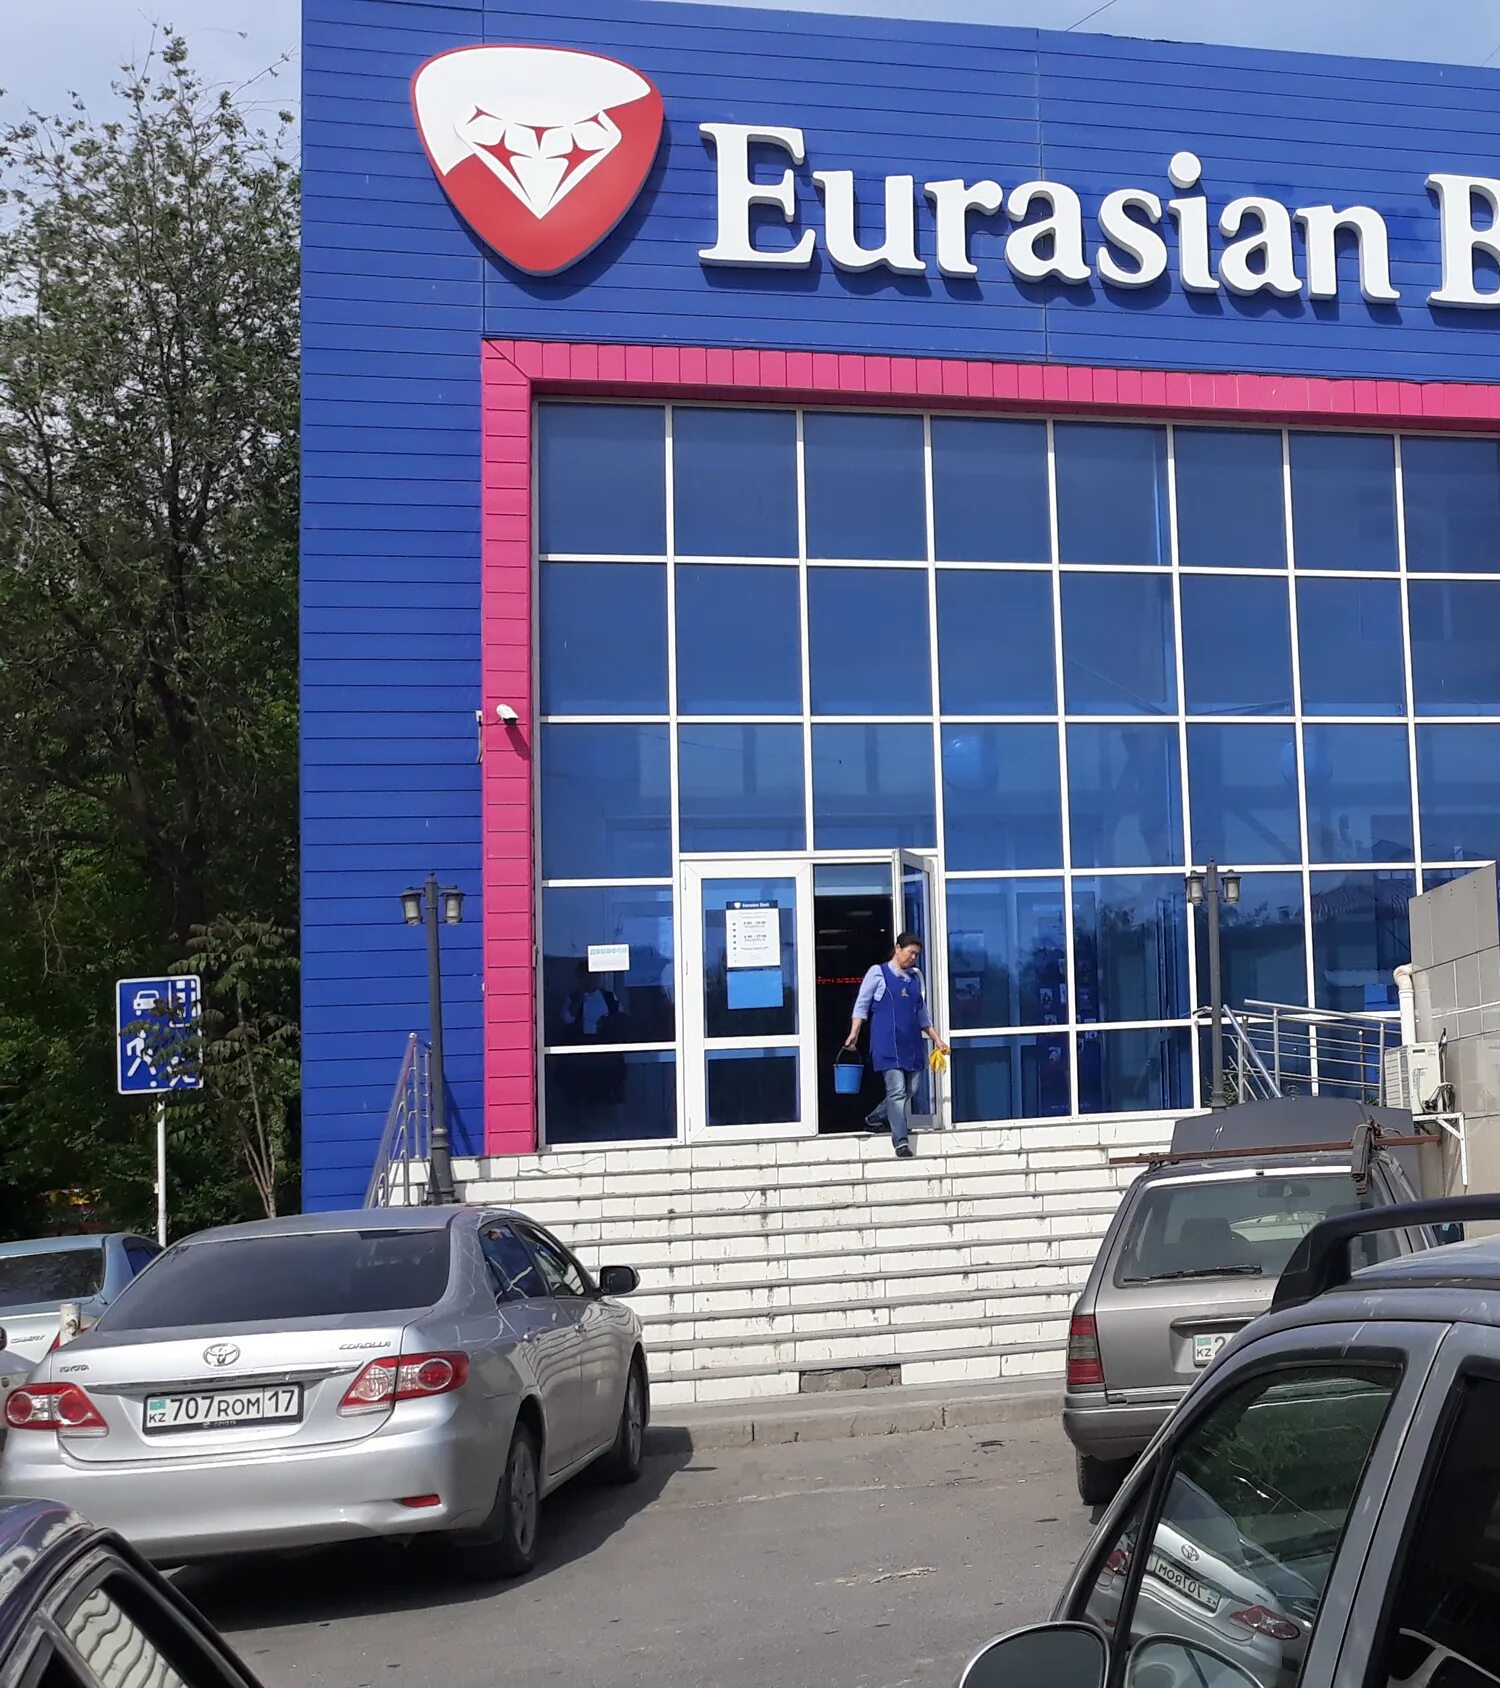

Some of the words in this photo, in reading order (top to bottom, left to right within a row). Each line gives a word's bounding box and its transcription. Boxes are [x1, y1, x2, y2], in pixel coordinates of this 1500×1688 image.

[698, 122, 1400, 307] Eurasian
[1196, 1348, 1212, 1358] KZ
[149, 1412, 167, 1424] KZ
[268, 1389, 295, 1413] 17
